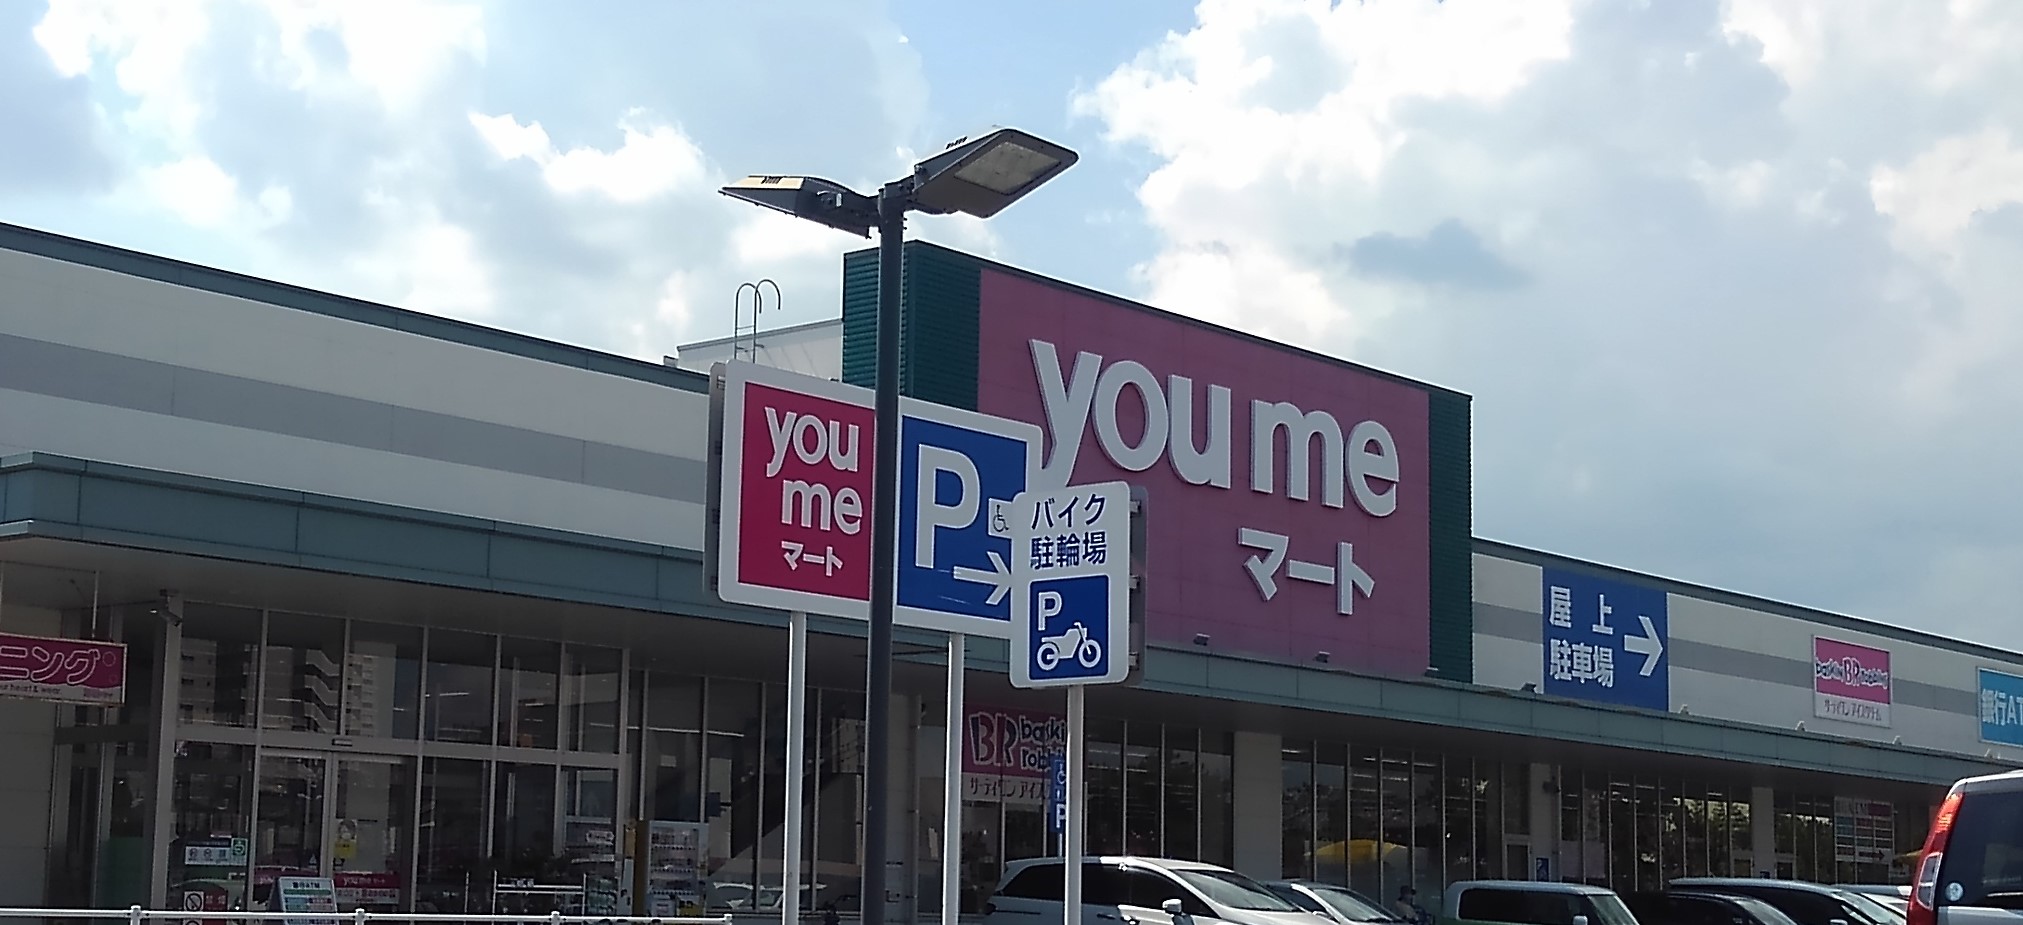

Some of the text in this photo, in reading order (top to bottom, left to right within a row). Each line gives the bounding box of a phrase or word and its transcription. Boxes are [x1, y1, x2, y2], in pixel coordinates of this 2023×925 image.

[764, 406, 860, 478] you
[1028, 338, 1400, 518] you me
[781, 478, 863, 535] me
[915, 442, 981, 570] P
[1031, 492, 1107, 531] バイク
[780, 540, 844, 577] マート
[1030, 531, 1108, 570] 駐輪場
[1238, 526, 1376, 616] マート
[1036, 591, 1063, 632] P
[1549, 638, 1614, 688] 駐車場
[1019, 715, 1066, 745] baski
